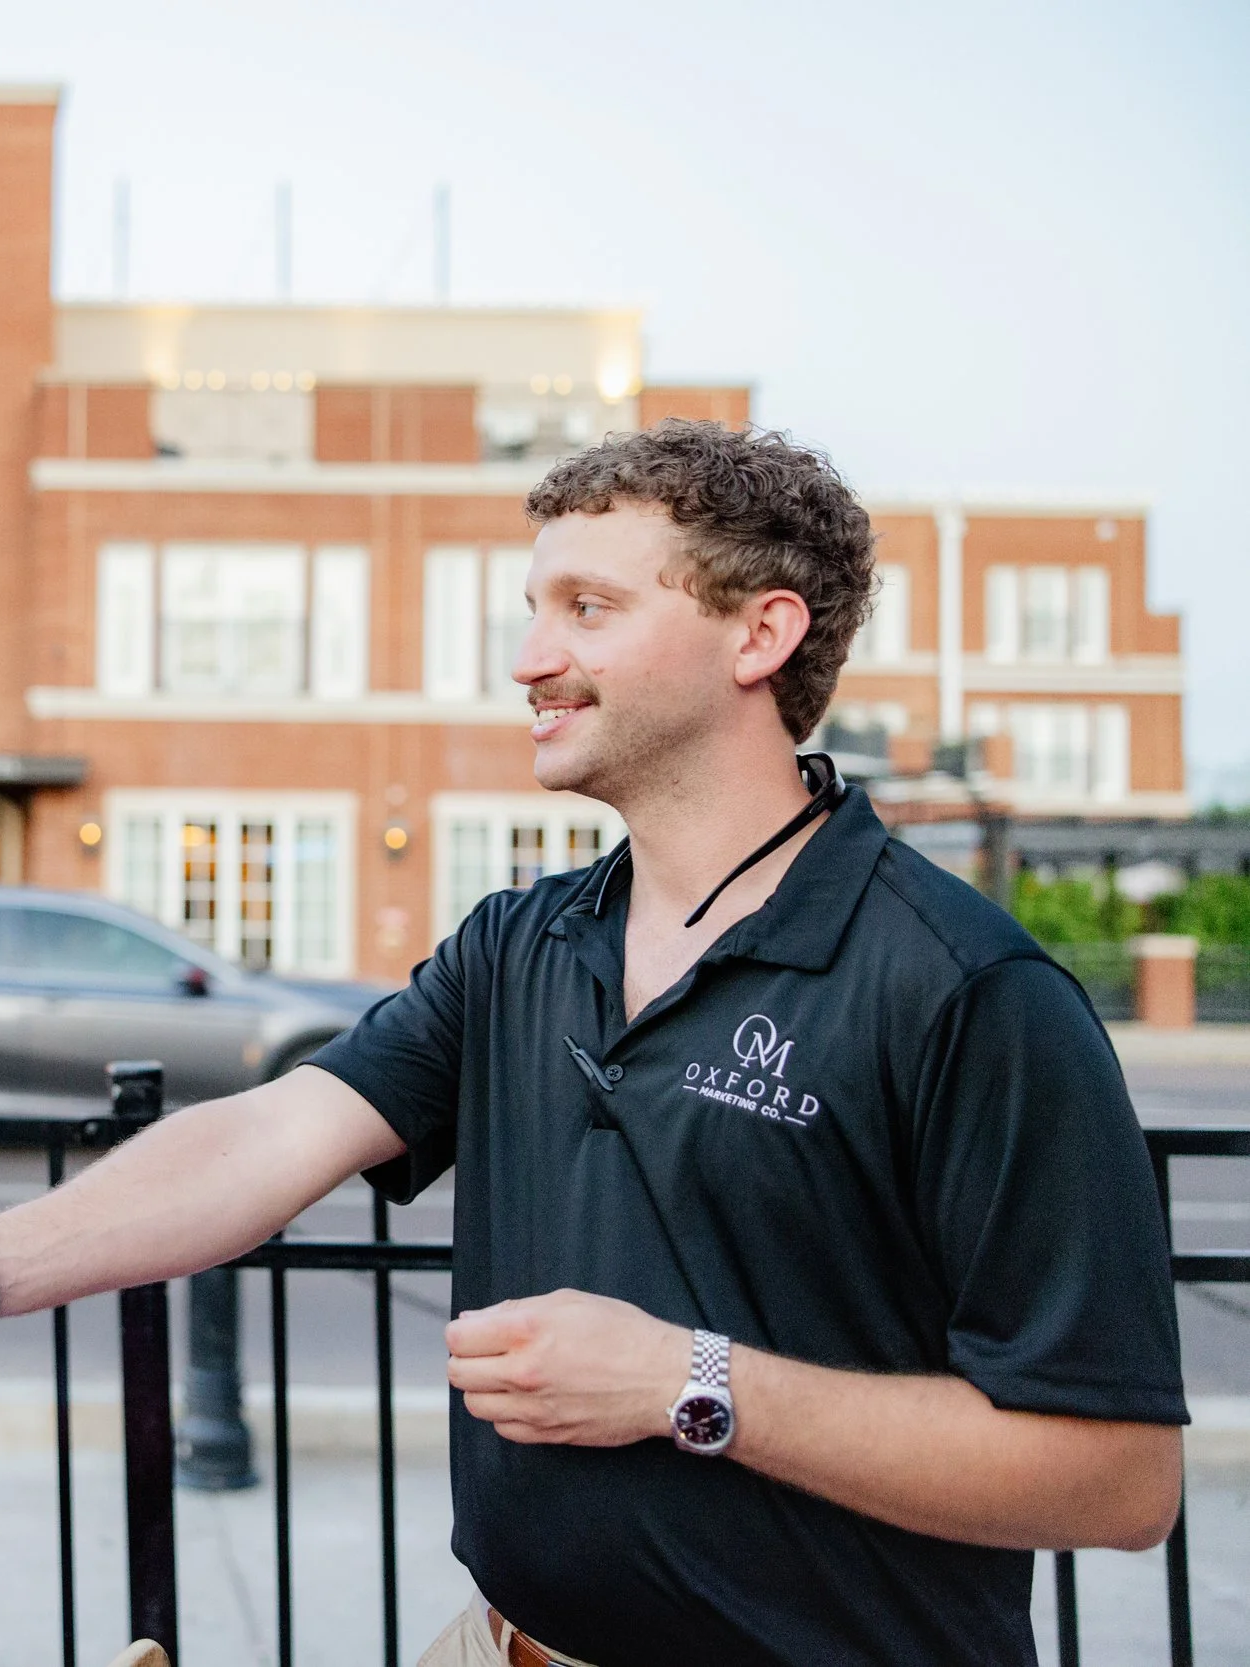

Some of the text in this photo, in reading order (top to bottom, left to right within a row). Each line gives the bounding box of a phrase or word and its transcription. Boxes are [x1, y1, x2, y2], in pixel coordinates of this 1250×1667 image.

[685, 1062, 820, 1116] OXFORD
[698, 1085, 782, 1120] MARKETING CO.
